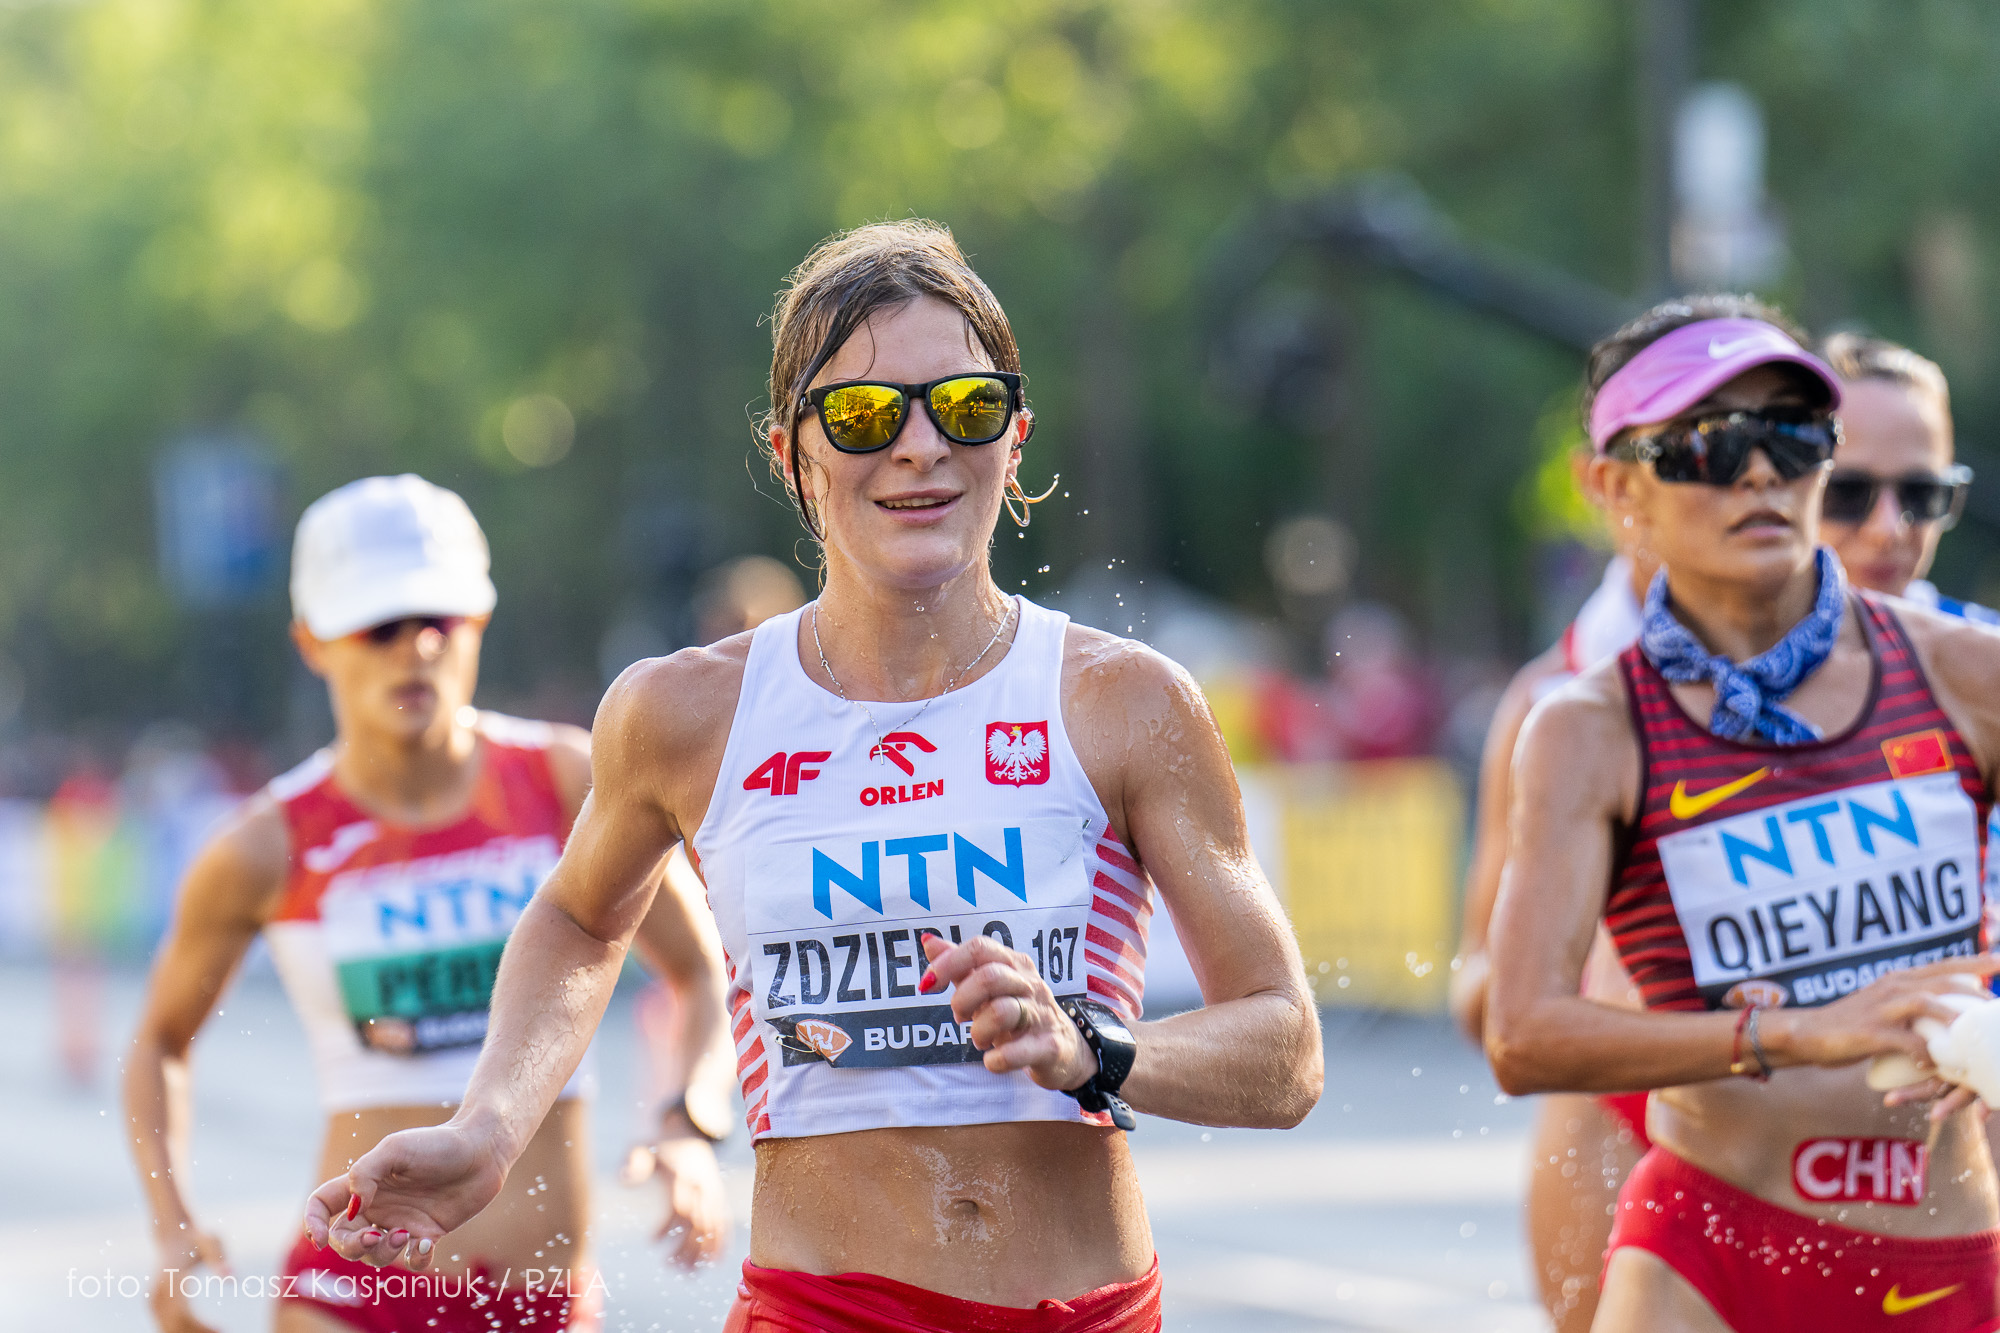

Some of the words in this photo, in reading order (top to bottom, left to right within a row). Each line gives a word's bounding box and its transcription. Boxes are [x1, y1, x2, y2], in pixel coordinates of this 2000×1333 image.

[743, 751, 832, 796] 4F
[859, 778, 944, 807] ORLEN
[1720, 789, 1920, 887] NTN
[812, 827, 1027, 920] NTN
[1708, 861, 1966, 976] QIEYANG
[1032, 926, 1079, 984] 167
[1795, 1139, 1927, 1201] CHN
